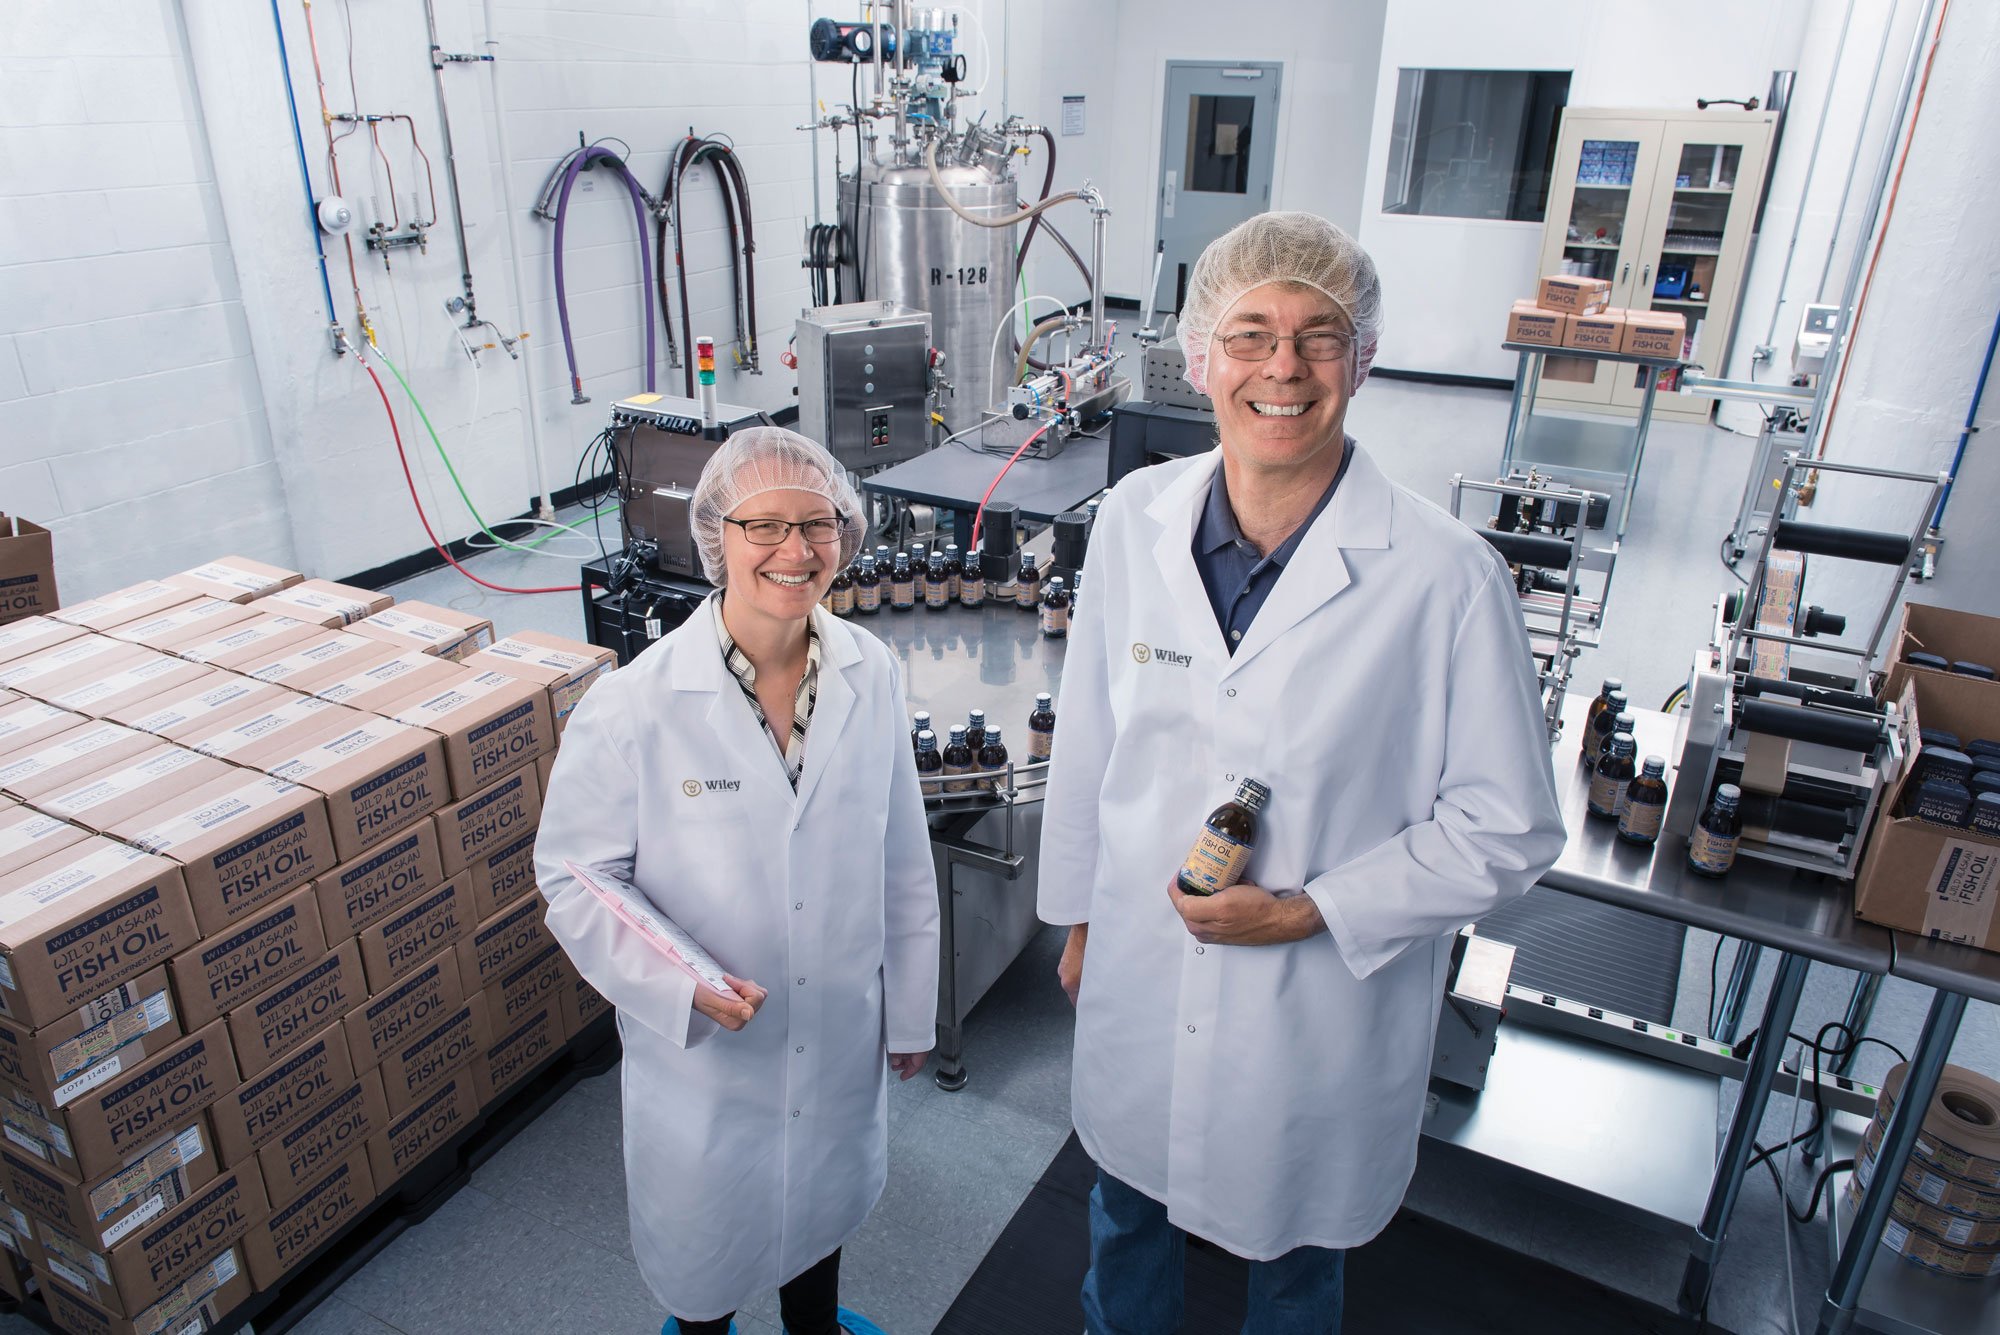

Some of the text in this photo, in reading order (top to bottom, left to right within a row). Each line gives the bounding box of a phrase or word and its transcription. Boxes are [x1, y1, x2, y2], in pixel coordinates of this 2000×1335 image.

[931, 267, 987, 286] R-128
[1546, 293, 1576, 305] FISH OIL
[1517, 328, 1552, 338] FISH OIL
[1574, 334, 1611, 344] FISH OIL
[1632, 340, 1670, 350] FISH OIL
[12, 595, 42, 609] OIL
[1154, 648, 1192, 668] Wiley
[244, 723, 269, 737] FISH
[334, 735, 377, 754] FISH OIL
[472, 729, 538, 775] FISH OIL
[354, 758, 417, 797] WILEY'S FINEST
[354, 766, 428, 815] WILD ALASKAN
[705, 779, 741, 791] Wiley
[356, 783, 432, 835] FISH OIL
[461, 804, 526, 852] FISH OIL
[1918, 806, 1959, 823] FISH OIL
[1973, 817, 1997, 829] FISH
[217, 819, 294, 863] WILEY'S FINEST
[218, 827, 308, 883] WILD ALASKAN
[344, 841, 409, 882] WILEY'S FINEST
[1202, 836, 1218, 850] FISH
[1217, 846, 1231, 858] OIL
[221, 845, 312, 905] FISH OIL
[344, 848, 420, 900] WILD ALASKAN
[346, 865, 424, 919] FISH OIL
[492, 865, 525, 898] FISH
[1959, 855, 1989, 900] FISH OIL
[51, 894, 145, 948] WILEY'S FINEST
[53, 902, 163, 970] WILD ALASKAN
[206, 912, 284, 960] WILEY'S FINEST
[388, 914, 460, 968] FISH OIL
[57, 923, 170, 993] FISH OIL
[207, 919, 298, 979] WILD ALASKAN
[209, 937, 303, 1000] FISH OIL
[478, 925, 542, 975] FISH OIL
[259, 962, 329, 1011] WILEY'S FINEST
[260, 968, 342, 1030] WILD ALASKAN
[506, 966, 564, 1016] FISH OIL
[80, 1029, 110, 1048] FISH OIL
[262, 986, 346, 1049] FISH OIL
[372, 992, 444, 1050] FISH OIL
[63, 1060, 117, 1095] LOT# 114879
[105, 1048, 192, 1104] WILEY'S FINEST
[242, 1048, 315, 1099] WILEY'S FINEST
[407, 1034, 476, 1090] FISH OIL
[491, 1034, 551, 1085] FISH OIL
[106, 1054, 208, 1124] WILD ALASKAN
[110, 1073, 213, 1145] FISH OIL
[243, 1053, 328, 1117] WILD ALASKAN
[246, 1071, 332, 1136] FISH OIL
[289, 1111, 368, 1177] FISH OIL
[393, 1106, 461, 1166] FISH OIL
[13, 1179, 78, 1229] FISH OIL
[117, 1173, 134, 1187] FISH
[109, 1198, 159, 1236] LOT# 114879
[146, 1184, 226, 1245] WILEY'S FINEST
[147, 1189, 240, 1263] WILD ALASKAN
[276, 1191, 355, 1260] FISH OIL
[150, 1207, 246, 1282] FISH OIL
